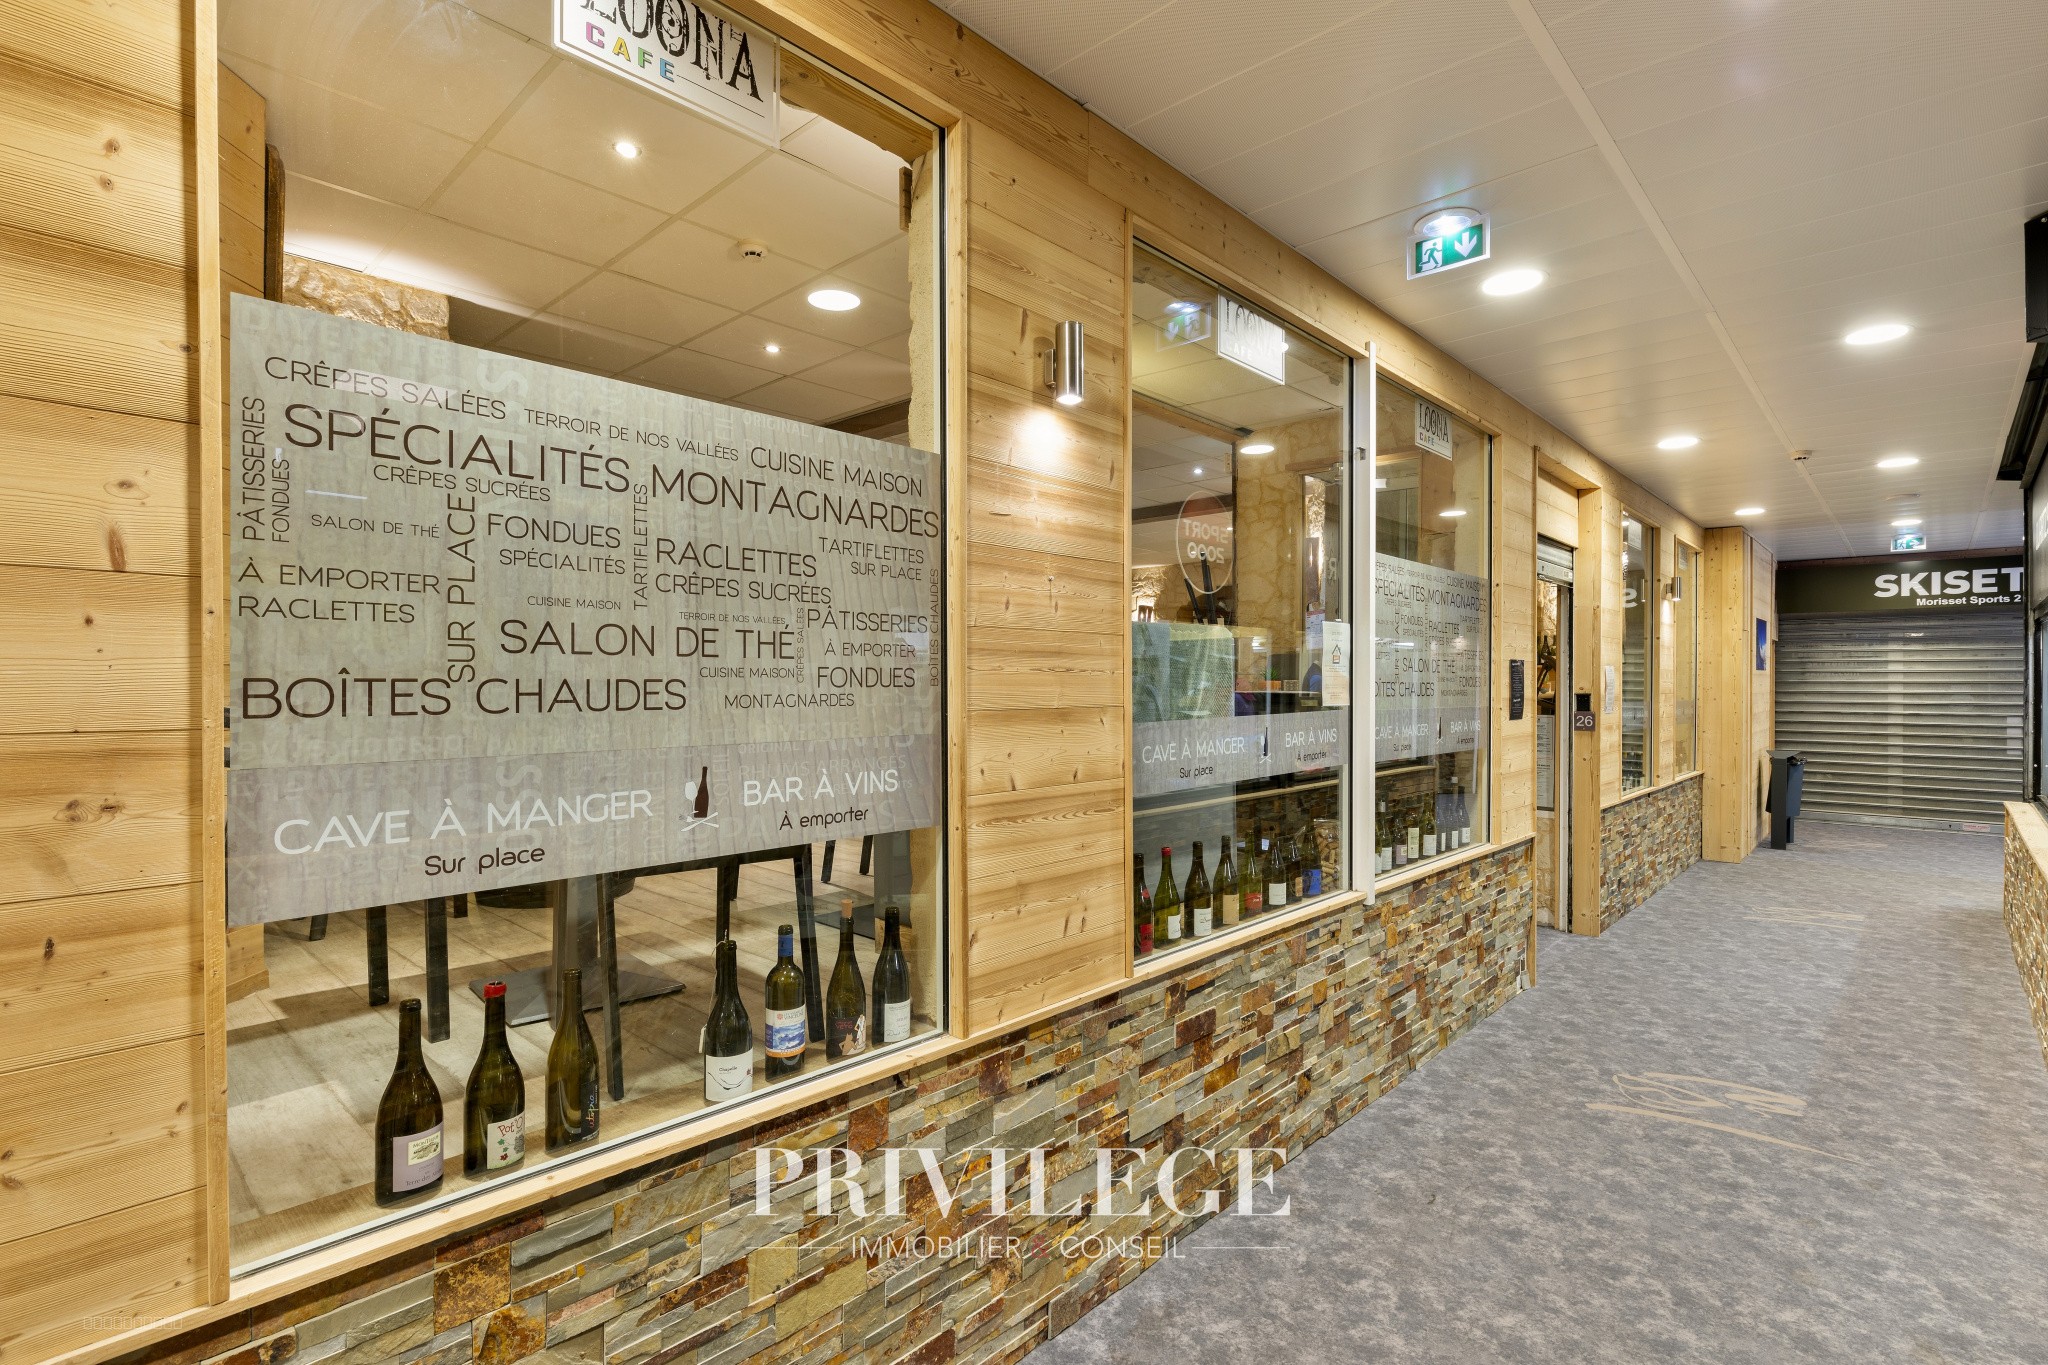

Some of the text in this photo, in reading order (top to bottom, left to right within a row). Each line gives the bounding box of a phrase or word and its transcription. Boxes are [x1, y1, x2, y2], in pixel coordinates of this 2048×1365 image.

[585, 21, 675, 83] CAFE
[265, 356, 507, 421] CRÊPES SALÉES
[523, 407, 739, 462] TERROIR DE NOS VALLÉES
[1419, 402, 1450, 443] LOONA
[284, 403, 630, 493] SPÉCIALITÉS
[236, 396, 266, 542] PÂTISSERIES
[373, 464, 551, 503] CRÊPES SUCRÉES
[750, 446, 835, 483] CUISINE
[843, 464, 923, 498] MAISON
[271, 458, 290, 543] FONDUES
[652, 463, 940, 539] MONTAGNARDES
[311, 513, 440, 539] SALON DE THÉ
[487, 513, 621, 549] FONDUES
[499, 548, 626, 575] SPÉCIALITÉS
[633, 483, 648, 611] TARTIFLETTES
[656, 537, 818, 578] RACLETTES
[819, 536, 925, 565] TARTIFLETTES
[238, 556, 441, 595] À EMPORTER
[447, 493, 476, 683] SUR PLACE
[655, 571, 832, 605] CRÊPES SUCRÉES
[850, 561, 923, 581] SUR PLACE
[1873, 566, 2025, 598] SKISET
[238, 595, 416, 624] RACLETTES
[527, 595, 621, 611] CUISINE MAISON
[1916, 594, 2022, 607] Morisset Sports 2
[679, 611, 786, 625] TERROIR DE NOS VALLÉES
[807, 605, 928, 634] PÂTISSERIES
[928, 568, 940, 687] BOÎTES CHAUDES
[499, 619, 795, 660] SALON DE THÉ
[824, 638, 916, 658] À EMPORTER
[699, 666, 795, 679] CUISINE MAISON
[796, 647, 805, 684] CRÊPES
[817, 666, 916, 689] FONDUES
[242, 667, 688, 720] BOÎTES CHAUDES
[724, 692, 855, 709] MONTAGNARDES
[1285, 728, 1338, 748] BAR À VINS
[1576, 715, 1594, 727] 26
[1142, 737, 1245, 765] CAVE À MANGER
[1303, 750, 1328, 763] emporter
[743, 776, 804, 807] BAR
[813, 769, 836, 800] À
[845, 769, 899, 795] VINS
[1179, 765, 1214, 779] Sur place
[274, 809, 411, 855] CAVE
[430, 798, 467, 840] À
[487, 788, 654, 834] MANGER
[779, 810, 793, 831] À
[799, 807, 869, 830] emporter
[424, 847, 546, 876] Sur place
